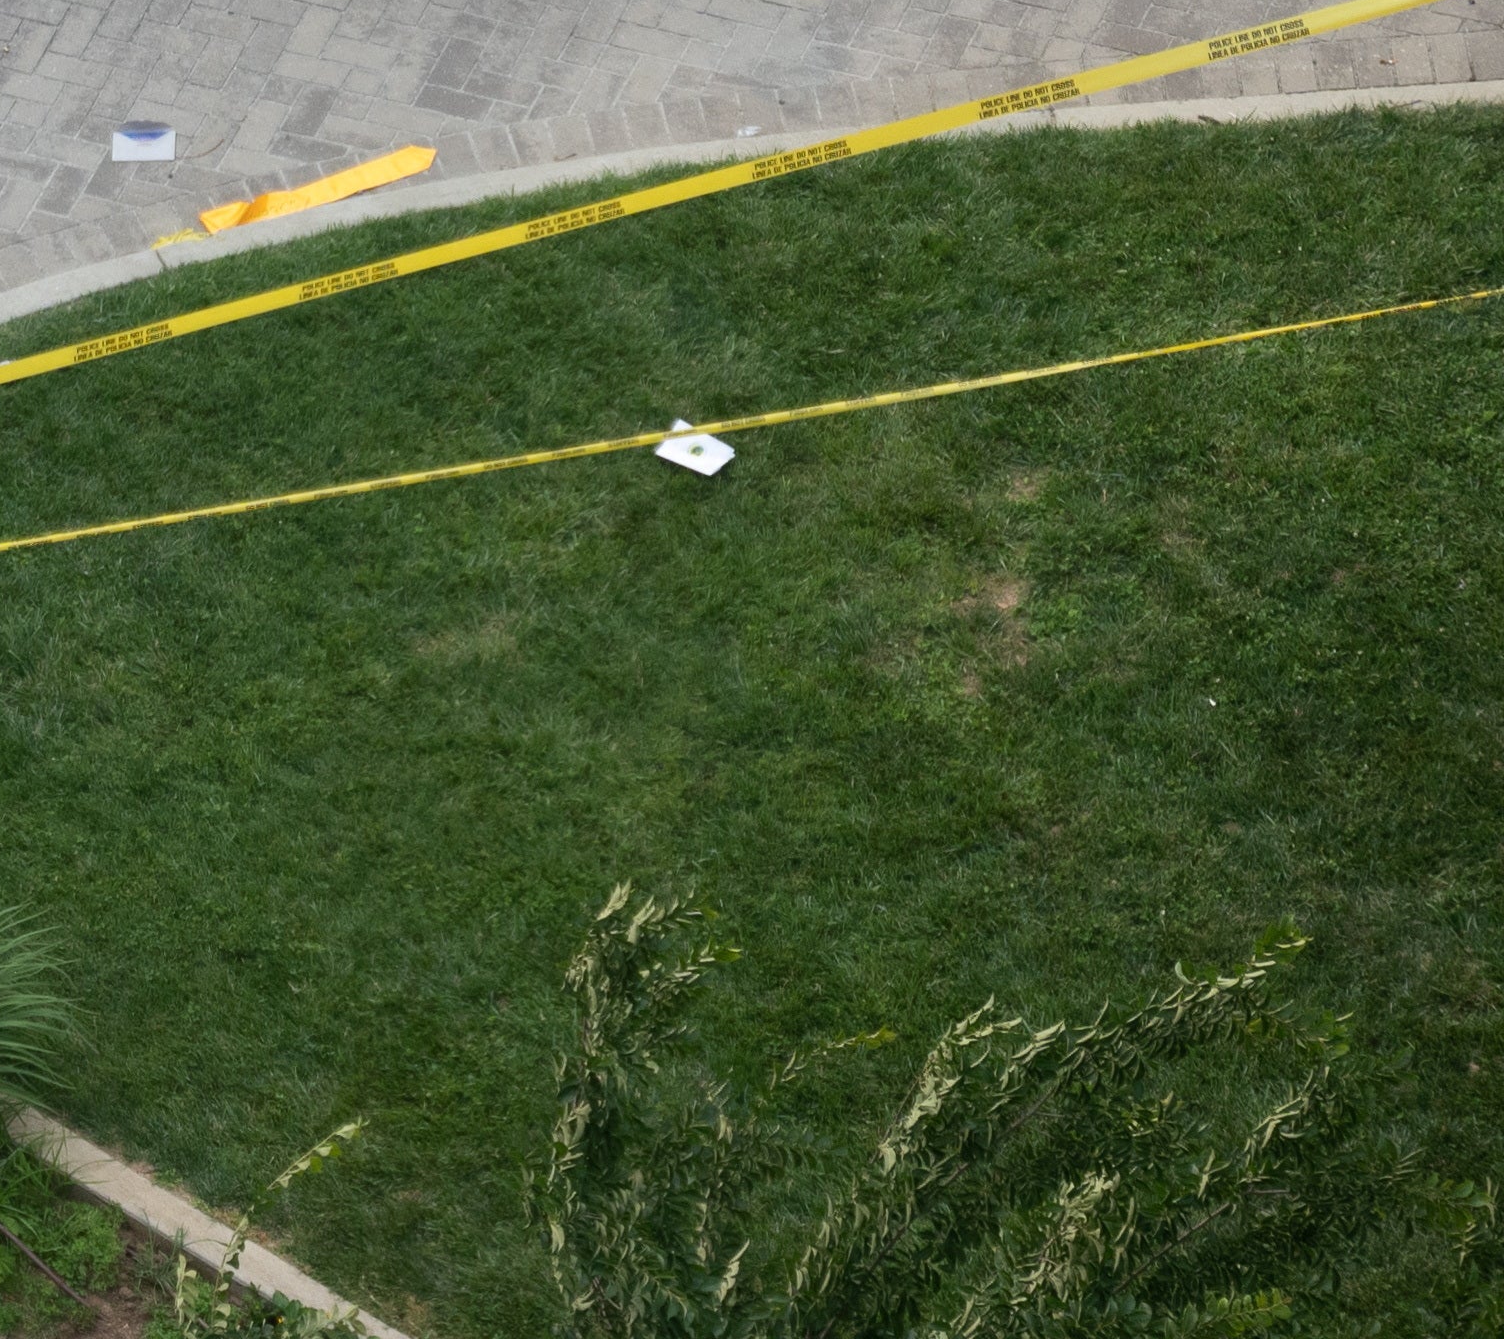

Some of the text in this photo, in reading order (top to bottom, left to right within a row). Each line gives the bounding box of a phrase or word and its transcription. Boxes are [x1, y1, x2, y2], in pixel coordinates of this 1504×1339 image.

[1208, 48, 1227, 60] LINEA
[1241, 38, 1267, 52] POLICIA
[1281, 27, 1309, 41] CRUZAR
[1209, 36, 1232, 50] POLICE
[1234, 32, 1249, 43] LINE
[1263, 25, 1277, 36] NOT
[1279, 18, 1303, 31] CROSS
[979, 108, 998, 120] LINEA
[1011, 97, 1038, 112] POLICIA
[1052, 86, 1079, 101] CRUZAR
[980, 97, 1004, 110] POLICE
[1006, 92, 1020, 103] LINE
[1034, 85, 1048, 96] NOT
[1051, 78, 1074, 91] CROSS
[751, 168, 771, 179] LINEA
[784, 157, 810, 171] POLICIA
[824, 146, 851, 160] CRUZAR
[753, 158, 777, 170] POLICE
[779, 153, 794, 163] LINE
[807, 146, 821, 156] NOT
[823, 139, 847, 152] CROSS
